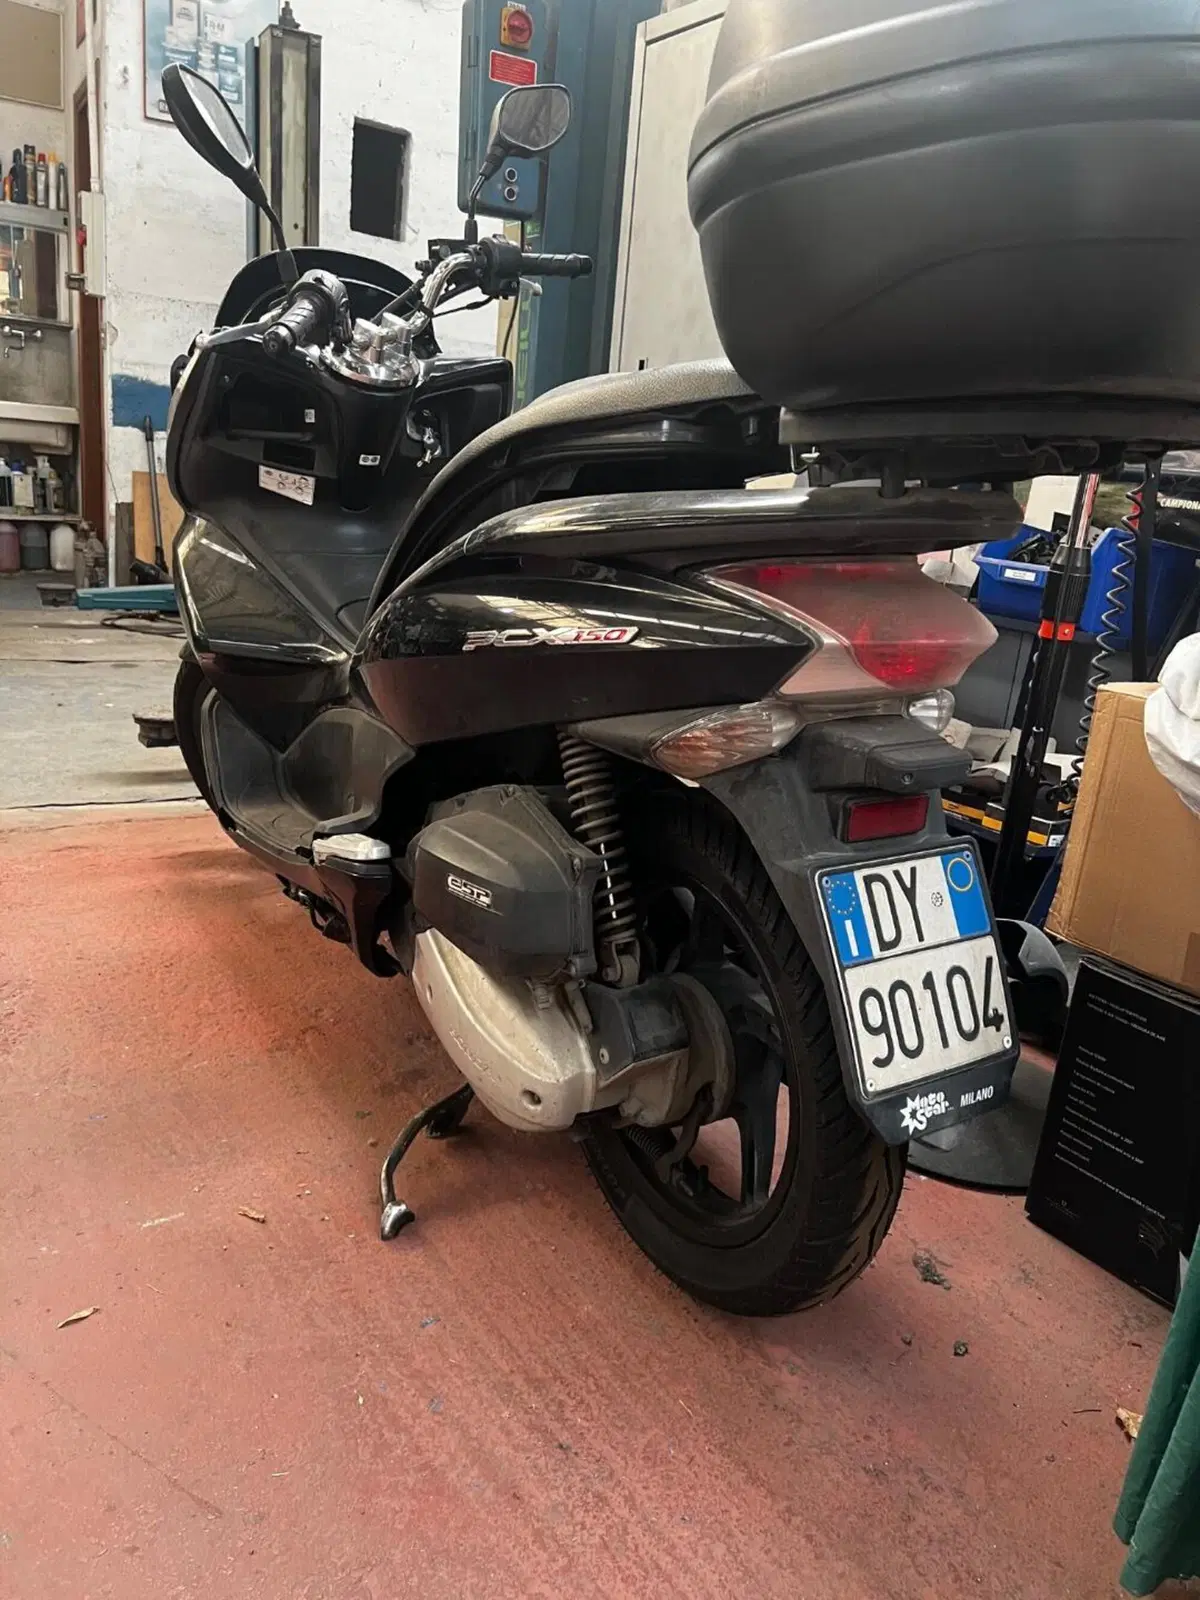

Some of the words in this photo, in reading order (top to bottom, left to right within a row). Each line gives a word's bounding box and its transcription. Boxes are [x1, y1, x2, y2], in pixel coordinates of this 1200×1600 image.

[462, 628, 566, 650] PCX
[573, 628, 629, 642] 150
[863, 867, 924, 951] DY
[859, 956, 1004, 1068] 90104
[960, 1085, 994, 1108] MILANO
